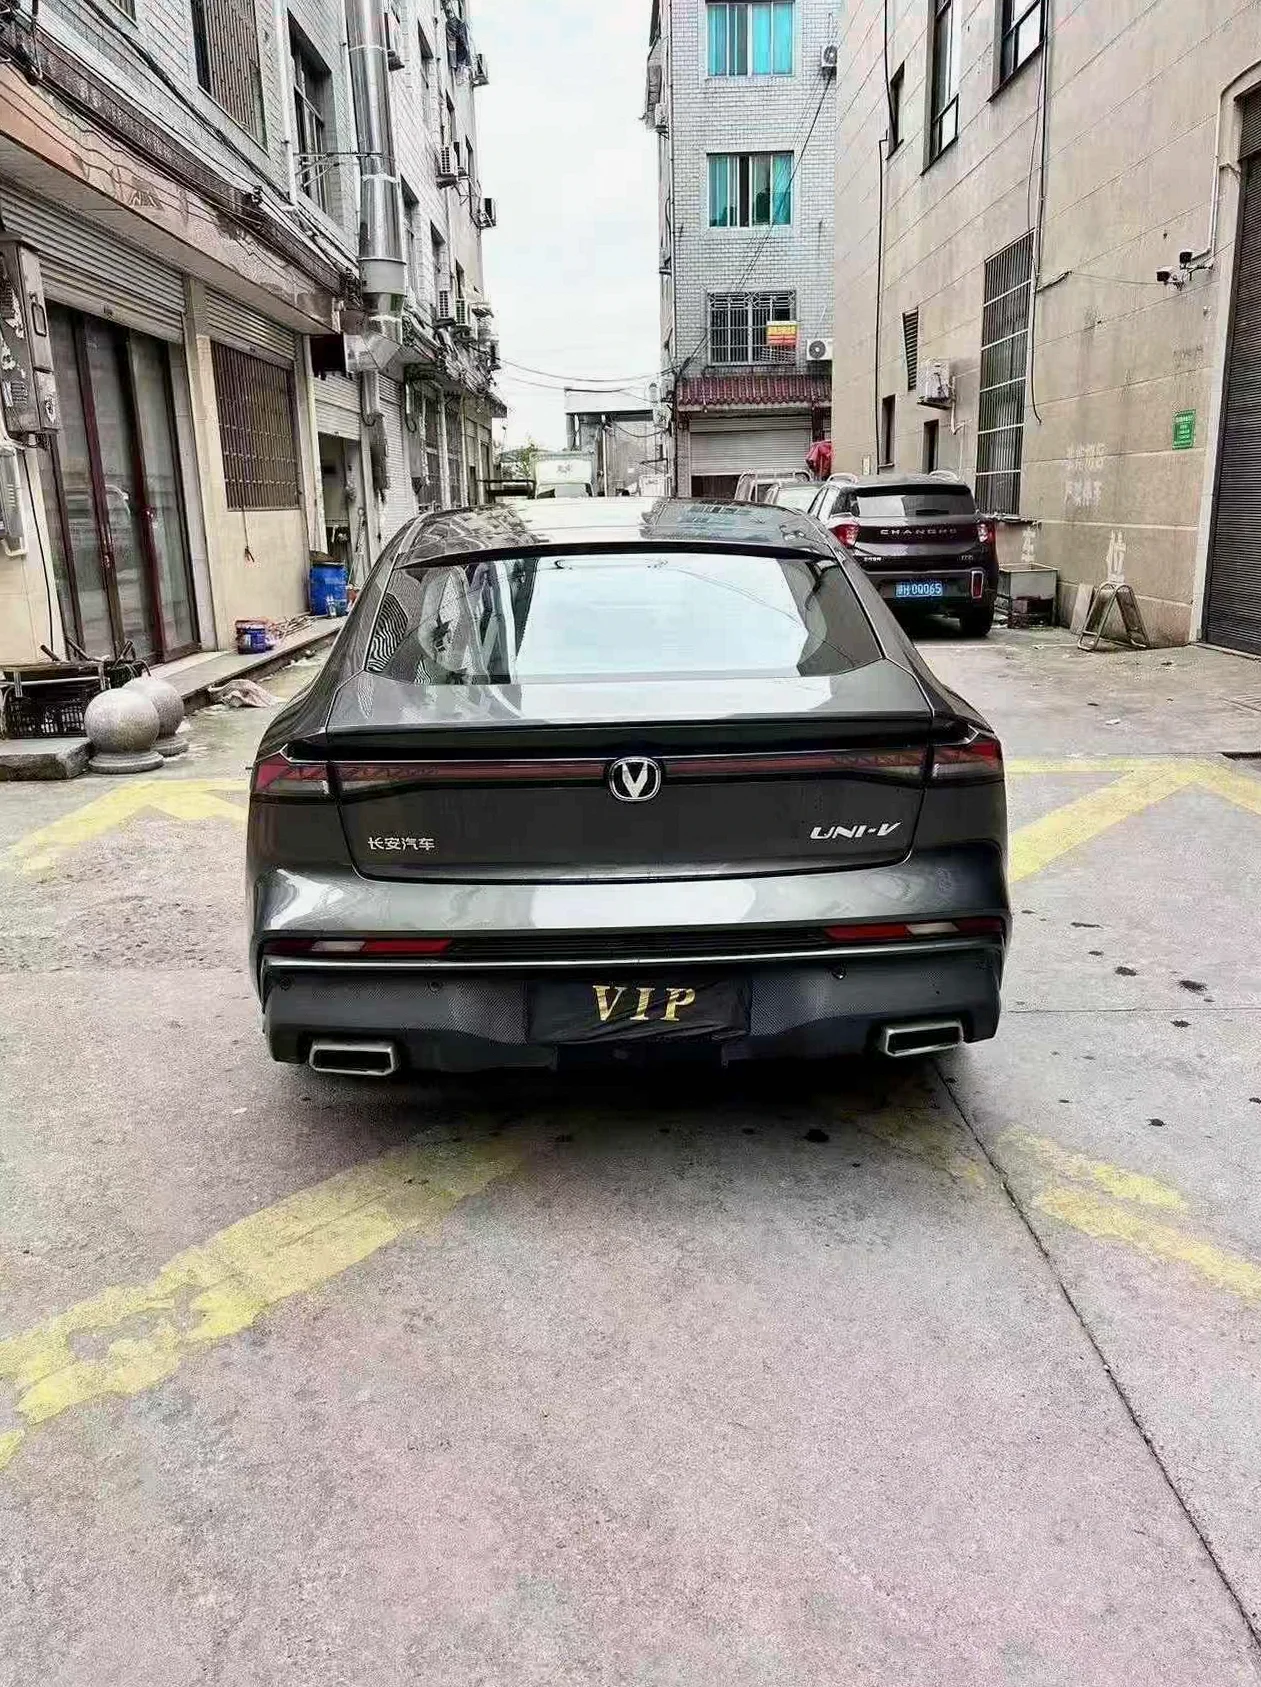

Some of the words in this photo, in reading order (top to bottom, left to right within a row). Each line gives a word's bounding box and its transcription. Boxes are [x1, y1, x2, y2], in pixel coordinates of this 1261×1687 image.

[810, 822, 901, 839] UNI-V
[367, 836, 435, 851] 长安汽车
[592, 985, 696, 1021] VIP
